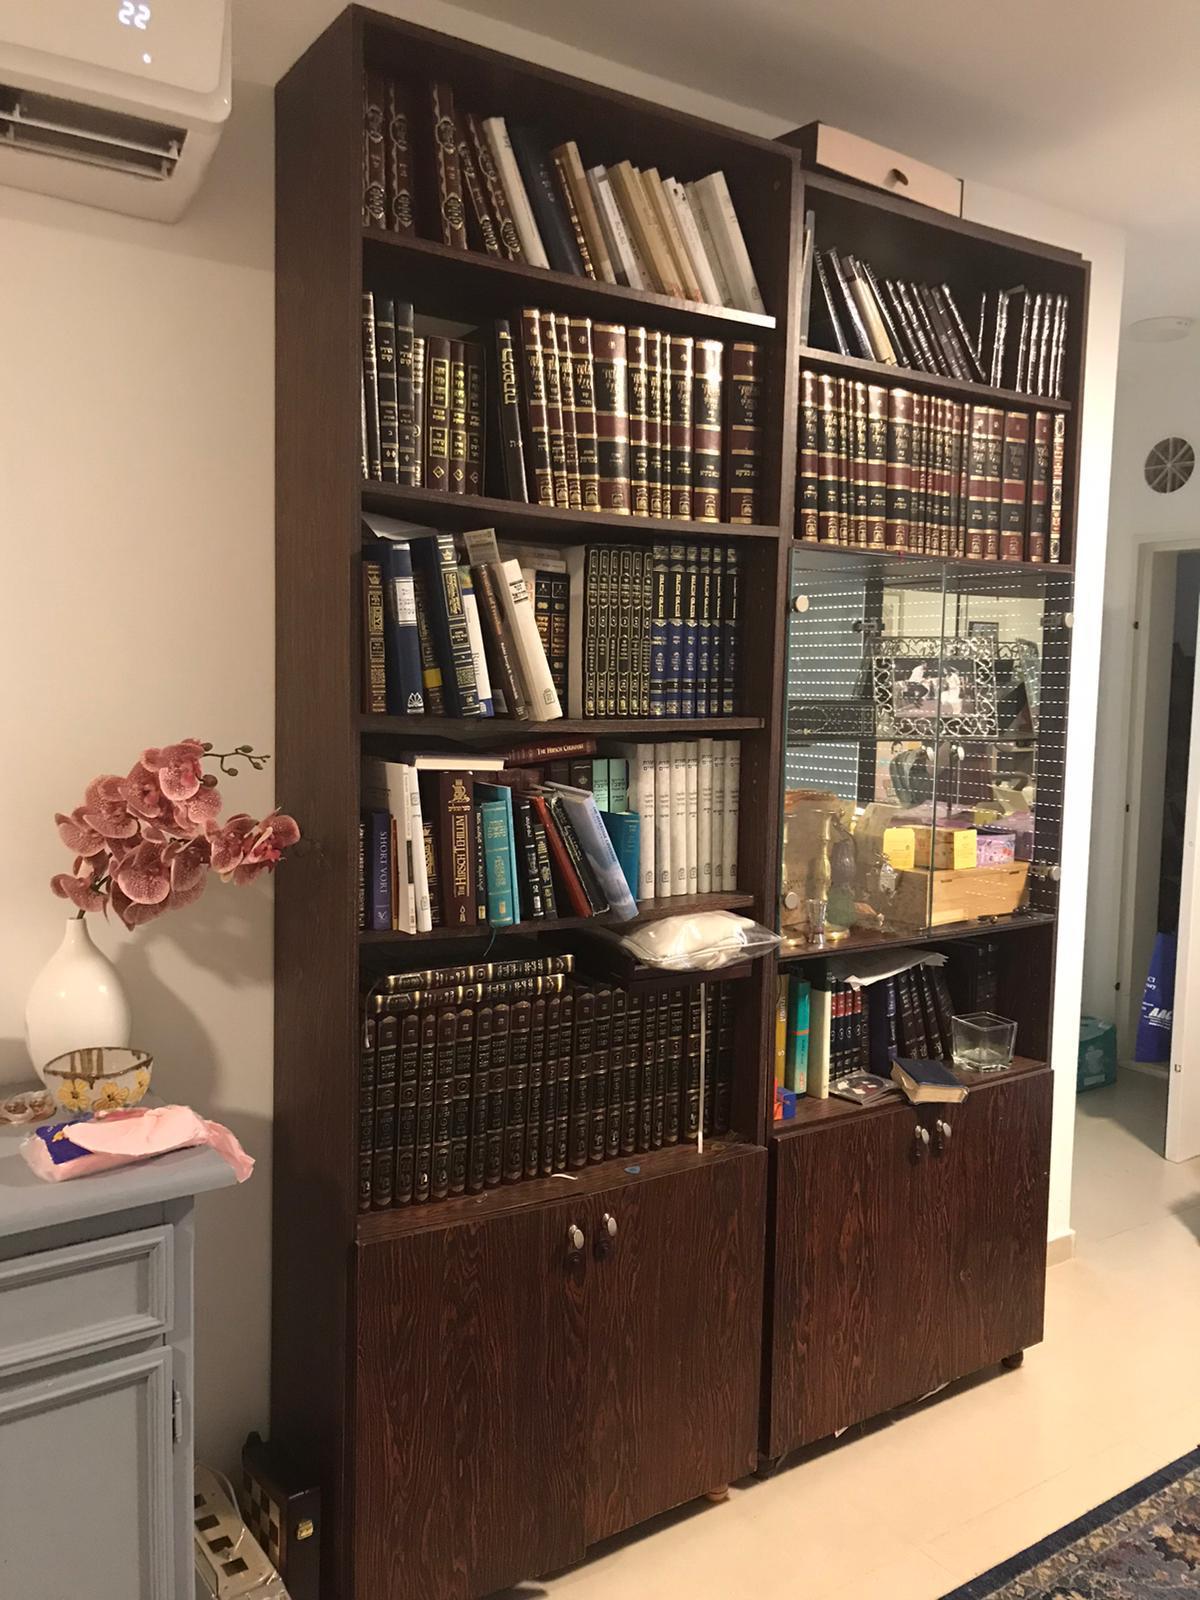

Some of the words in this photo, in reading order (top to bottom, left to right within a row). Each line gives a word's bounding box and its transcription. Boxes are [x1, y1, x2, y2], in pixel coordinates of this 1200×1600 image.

[118, 1, 151, 30] 22
[379, 831, 388, 864] SHORT
[452, 815, 466, 854] TEHILLIM
[379, 867, 388, 893] VORT
[454, 853, 467, 886] HIRSCH
